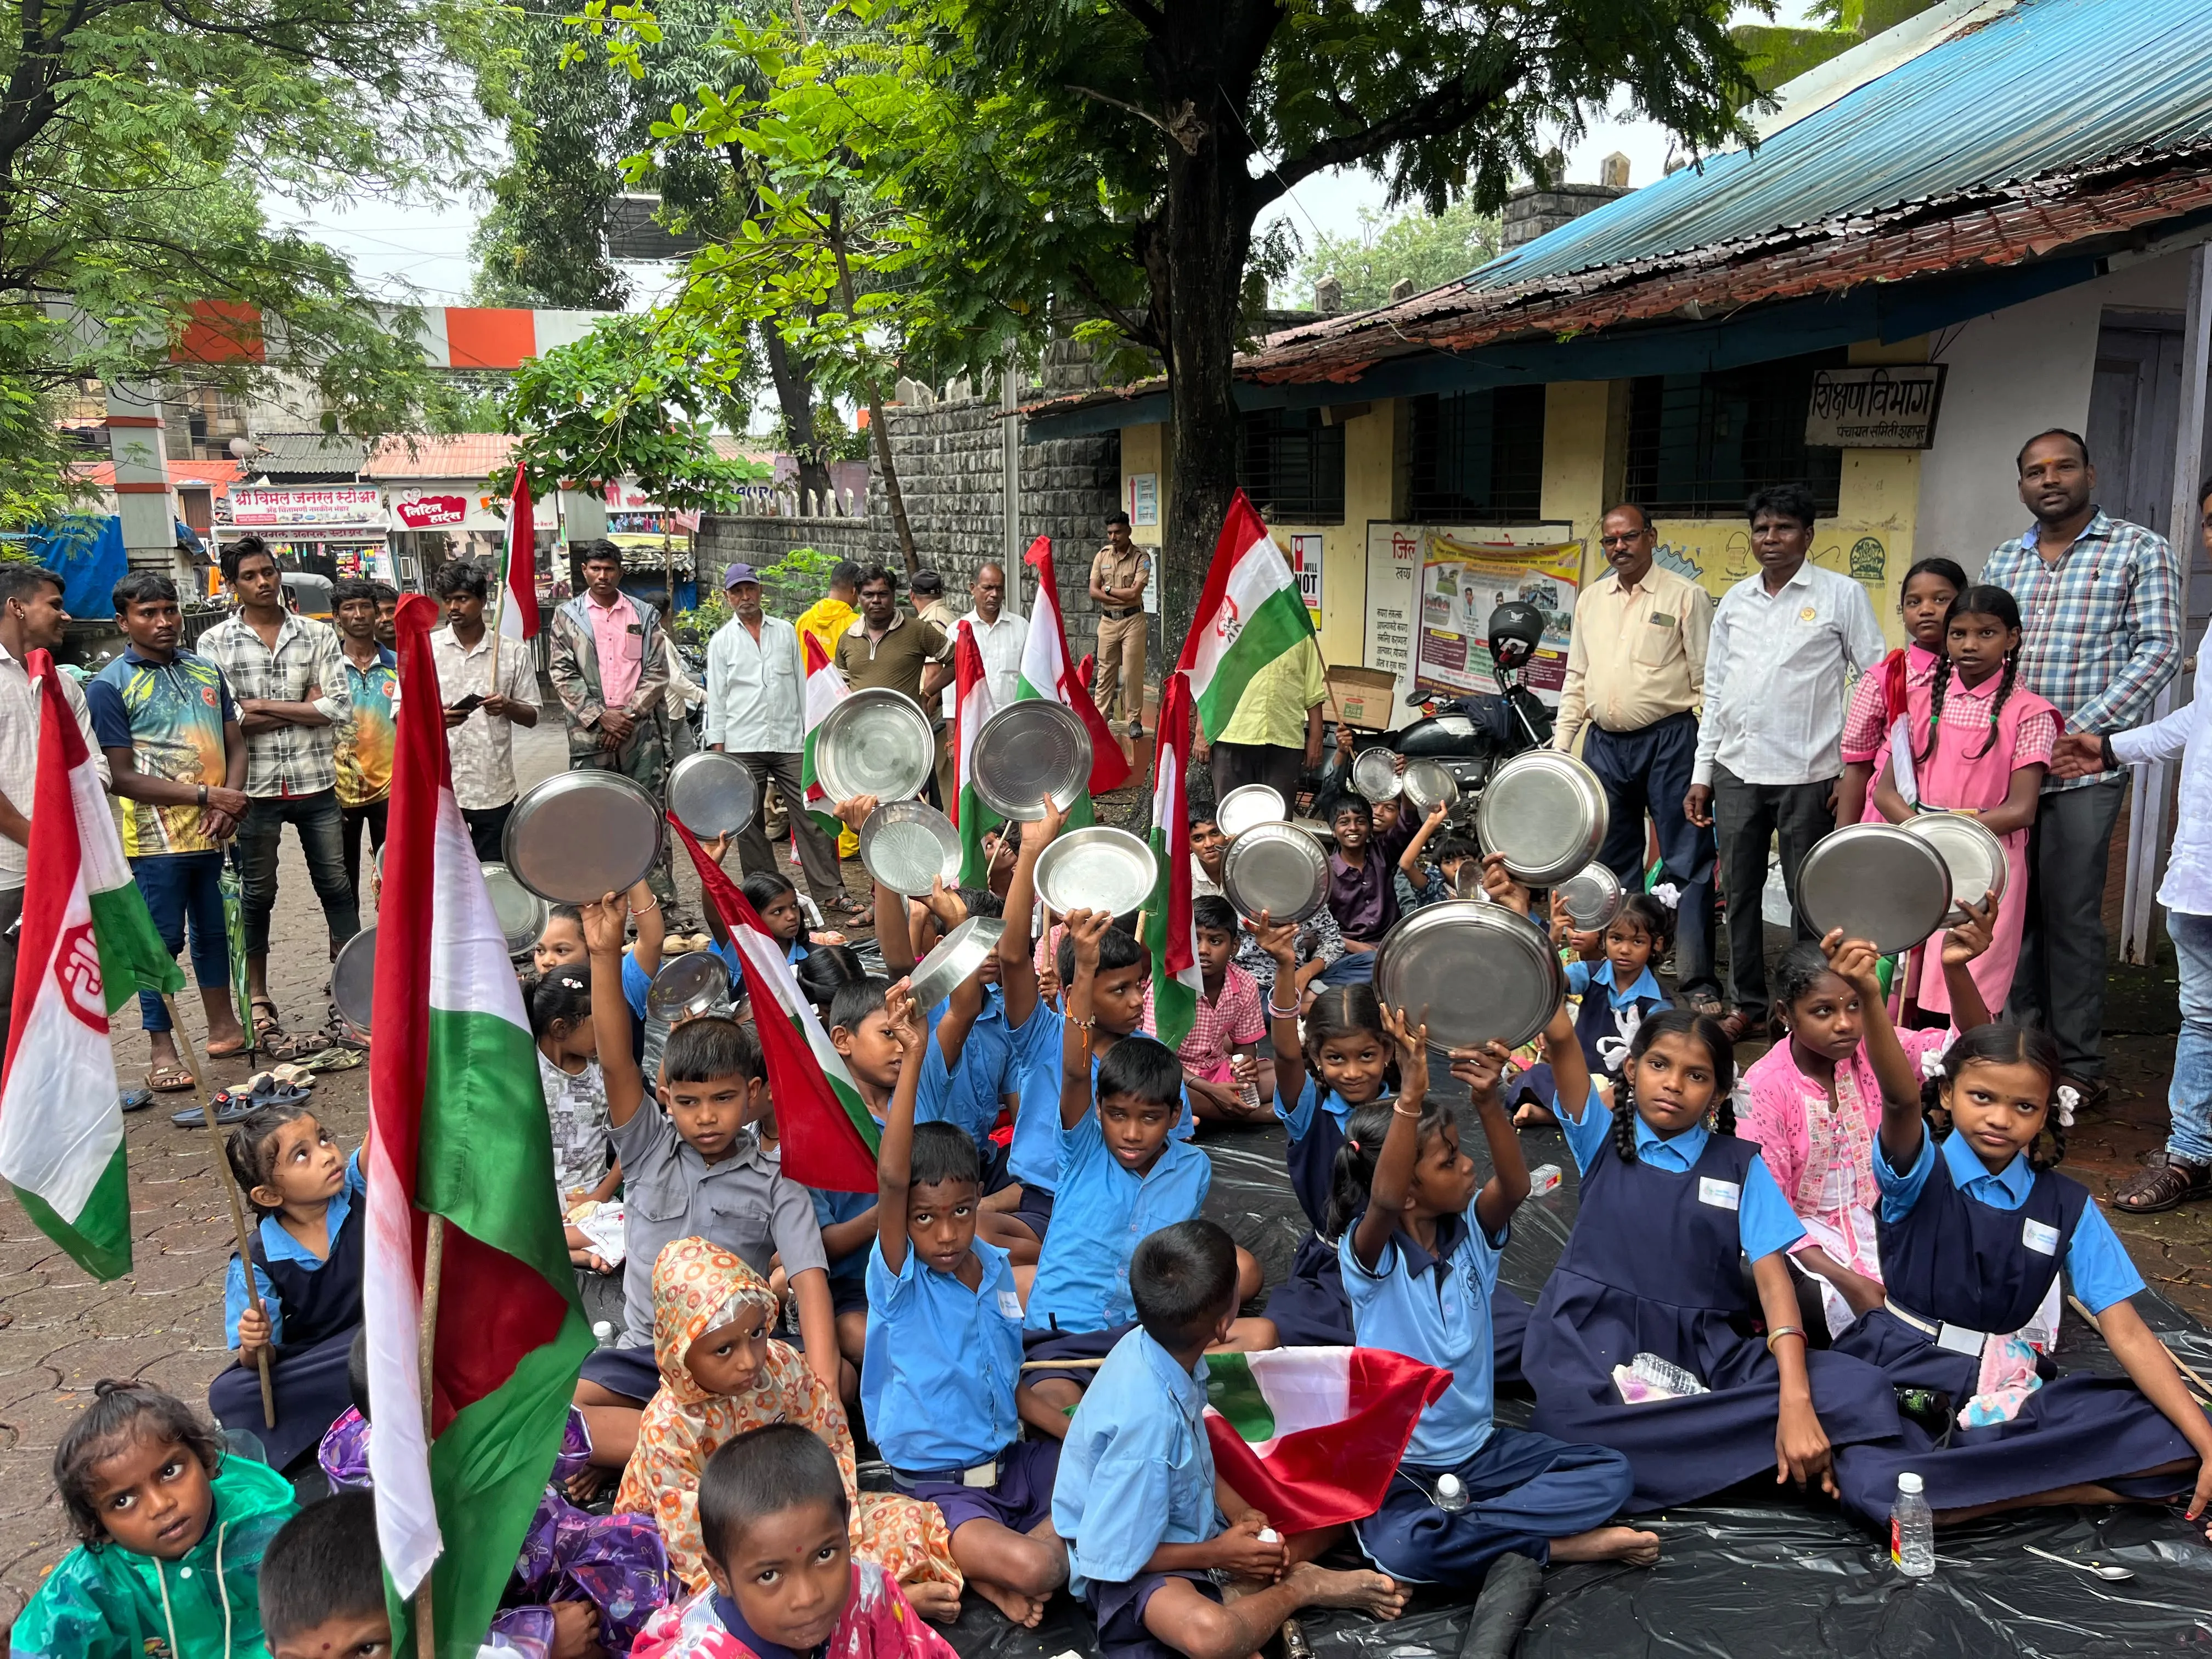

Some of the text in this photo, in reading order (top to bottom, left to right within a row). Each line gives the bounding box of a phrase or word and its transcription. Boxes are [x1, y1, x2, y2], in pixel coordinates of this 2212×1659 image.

[1812, 368, 1934, 420] शिक्षण विभाग
[1836, 424, 1869, 438] पंचायत
[1869, 420, 1899, 438] समिती
[235, 489, 251, 505] श्री
[253, 489, 290, 505] विमल
[292, 492, 334, 504] जनरल
[404, 503, 442, 517] लिटिल
[1304, 563, 1317, 572] WILL
[1295, 574, 1317, 594] NOT
